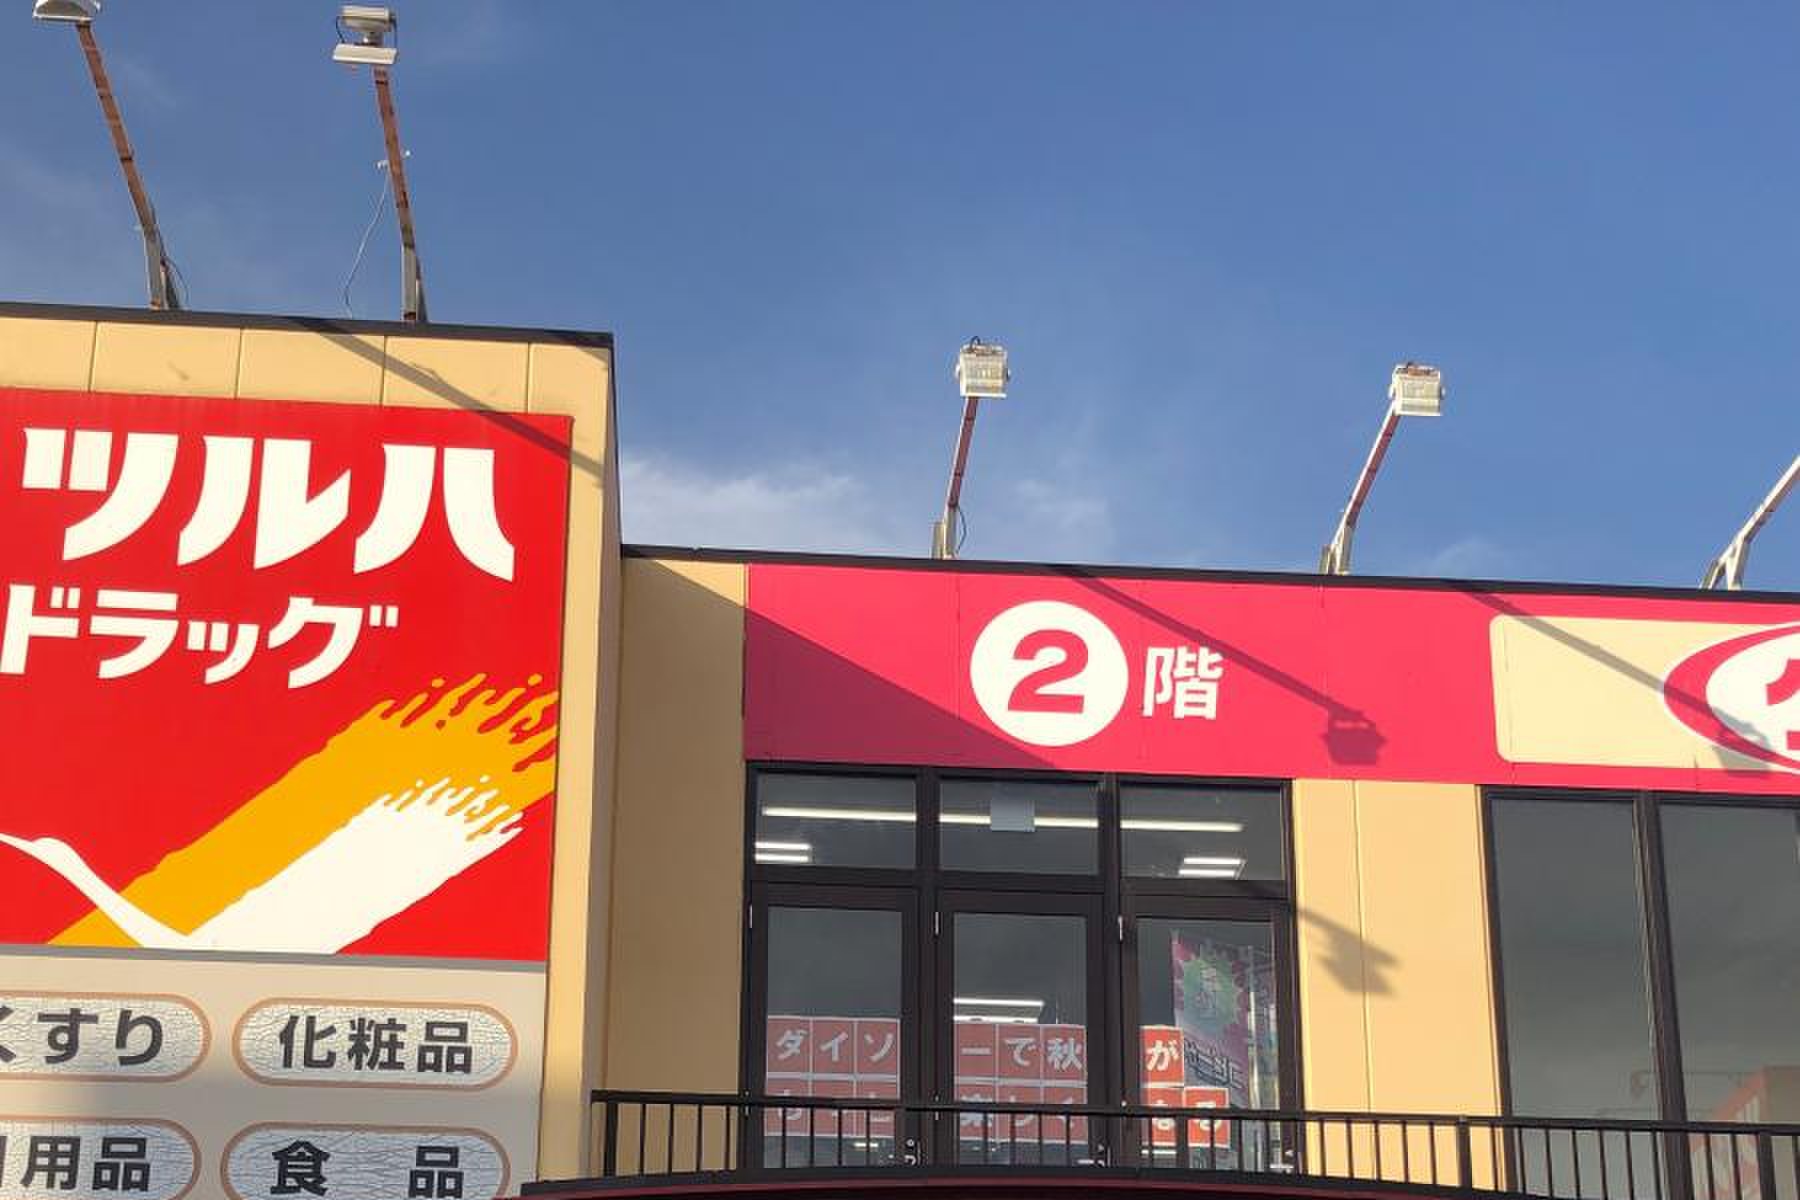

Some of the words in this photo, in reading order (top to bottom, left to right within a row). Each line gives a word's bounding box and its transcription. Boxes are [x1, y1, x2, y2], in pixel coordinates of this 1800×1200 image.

[22, 427, 515, 582] ツルハ
[0, 583, 399, 689] ドラッグ
[279, 1014, 473, 1074] 化粧品
[0, 1135, 151, 1192] 用品
[270, 1140, 464, 1199] 食品
